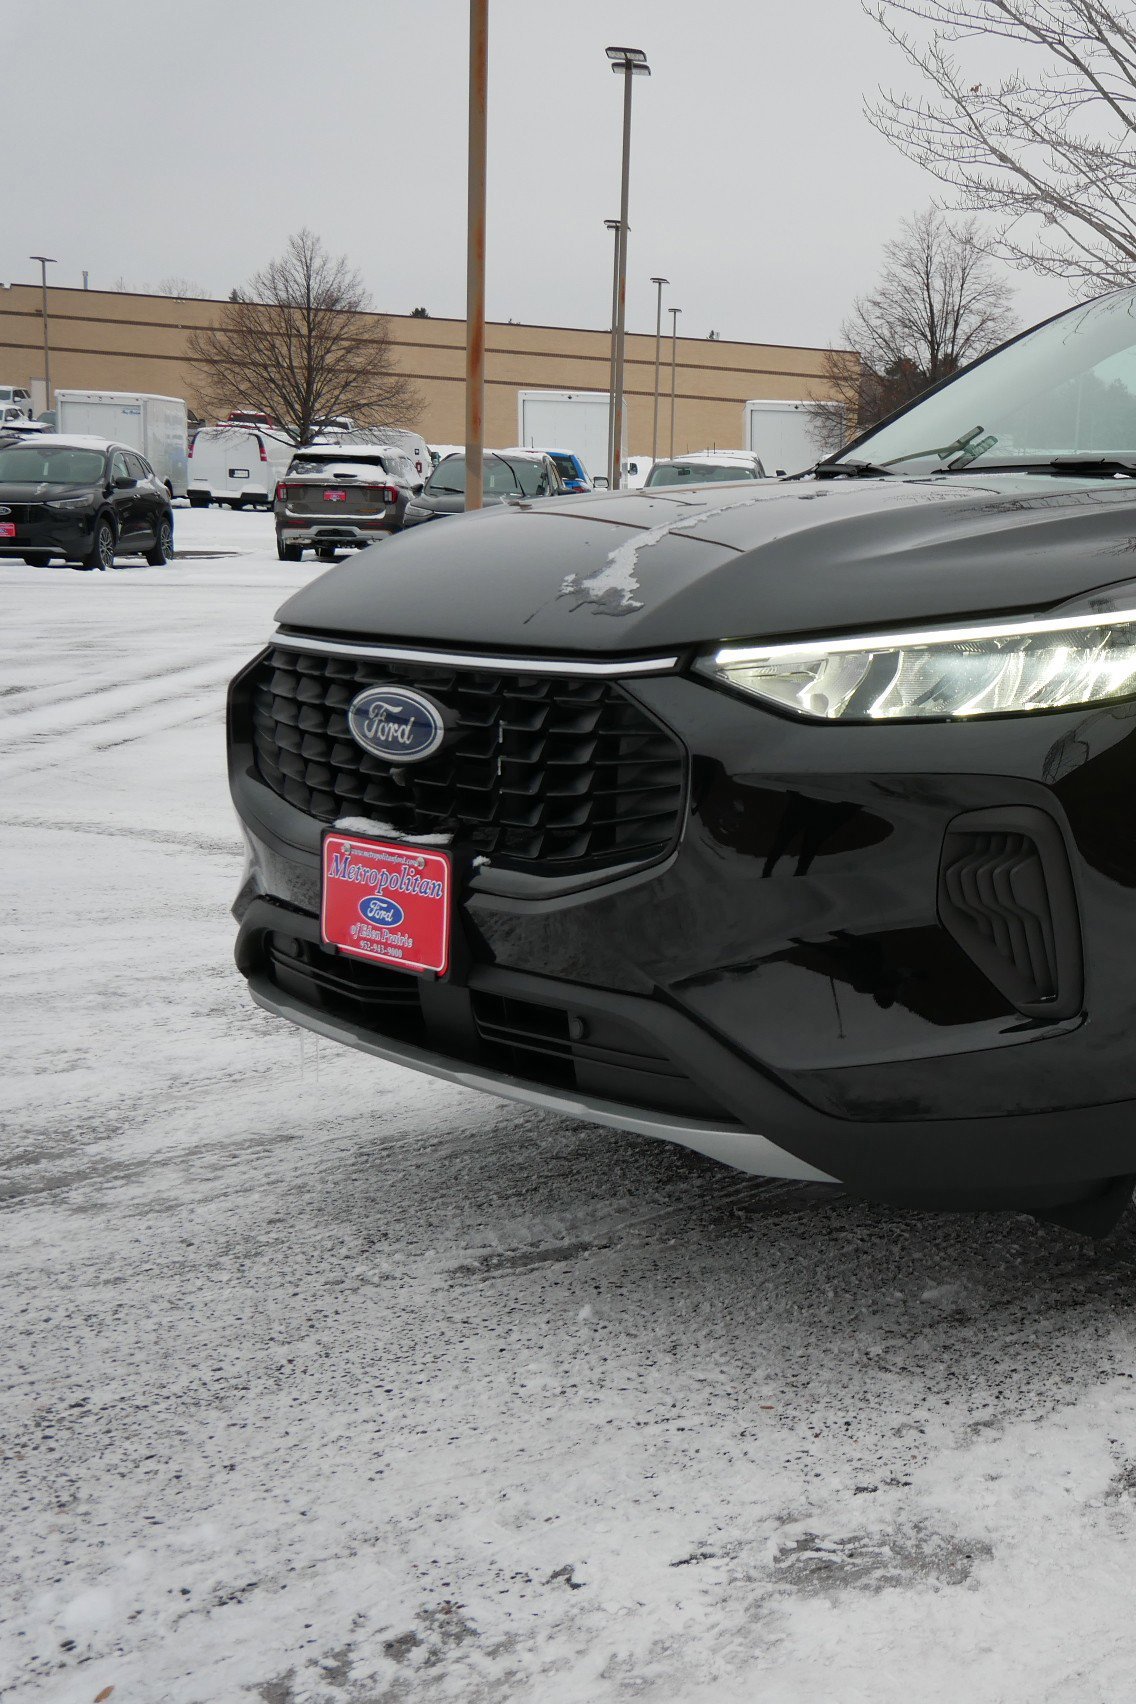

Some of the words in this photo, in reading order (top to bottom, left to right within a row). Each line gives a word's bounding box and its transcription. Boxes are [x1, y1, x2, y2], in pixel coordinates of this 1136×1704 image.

[365, 702, 415, 744] Ford
[329, 853, 443, 898] Metropolitan
[367, 900, 394, 922] Ford
[351, 923, 360, 939] of
[360, 924, 381, 940] Eden
